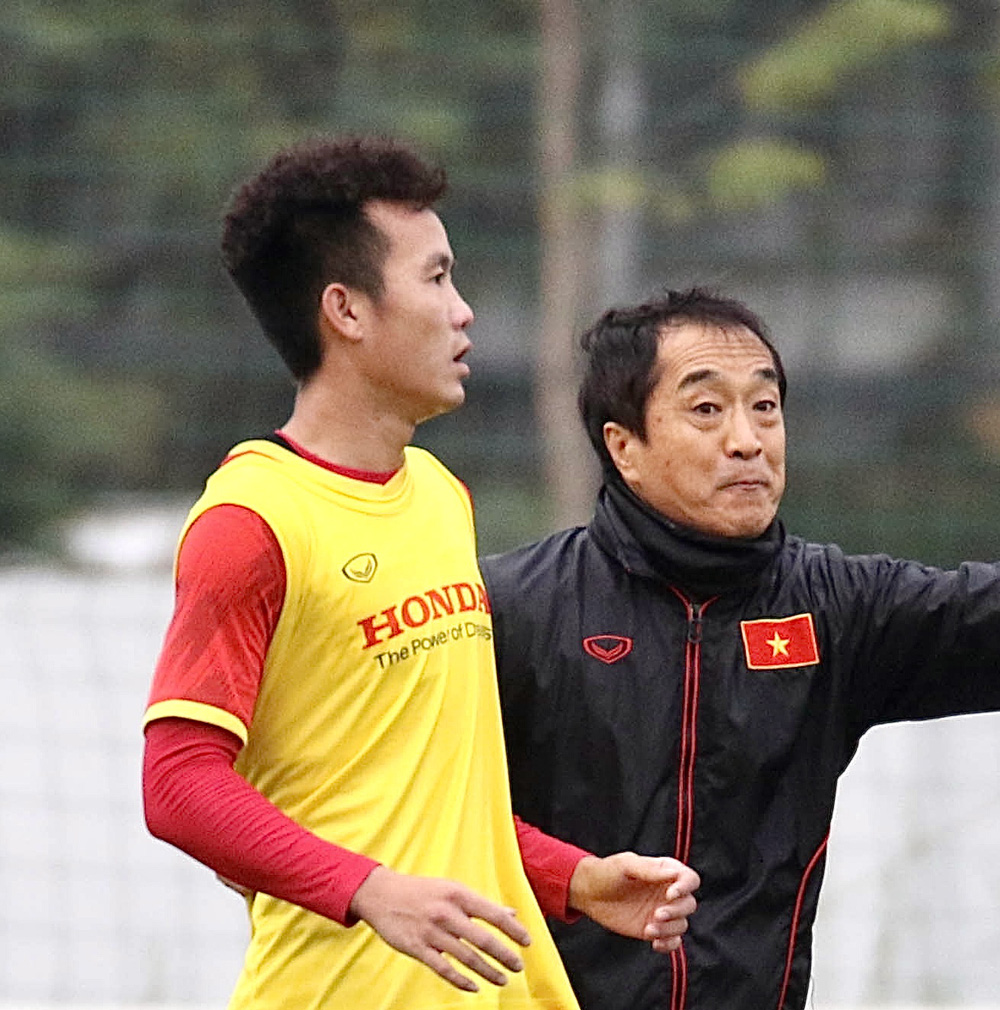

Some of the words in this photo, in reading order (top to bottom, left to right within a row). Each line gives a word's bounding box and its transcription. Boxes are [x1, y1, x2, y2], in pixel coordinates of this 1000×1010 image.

[357, 582, 491, 650] HONDA
[375, 647, 409, 669] The
[450, 623, 465, 641] of
